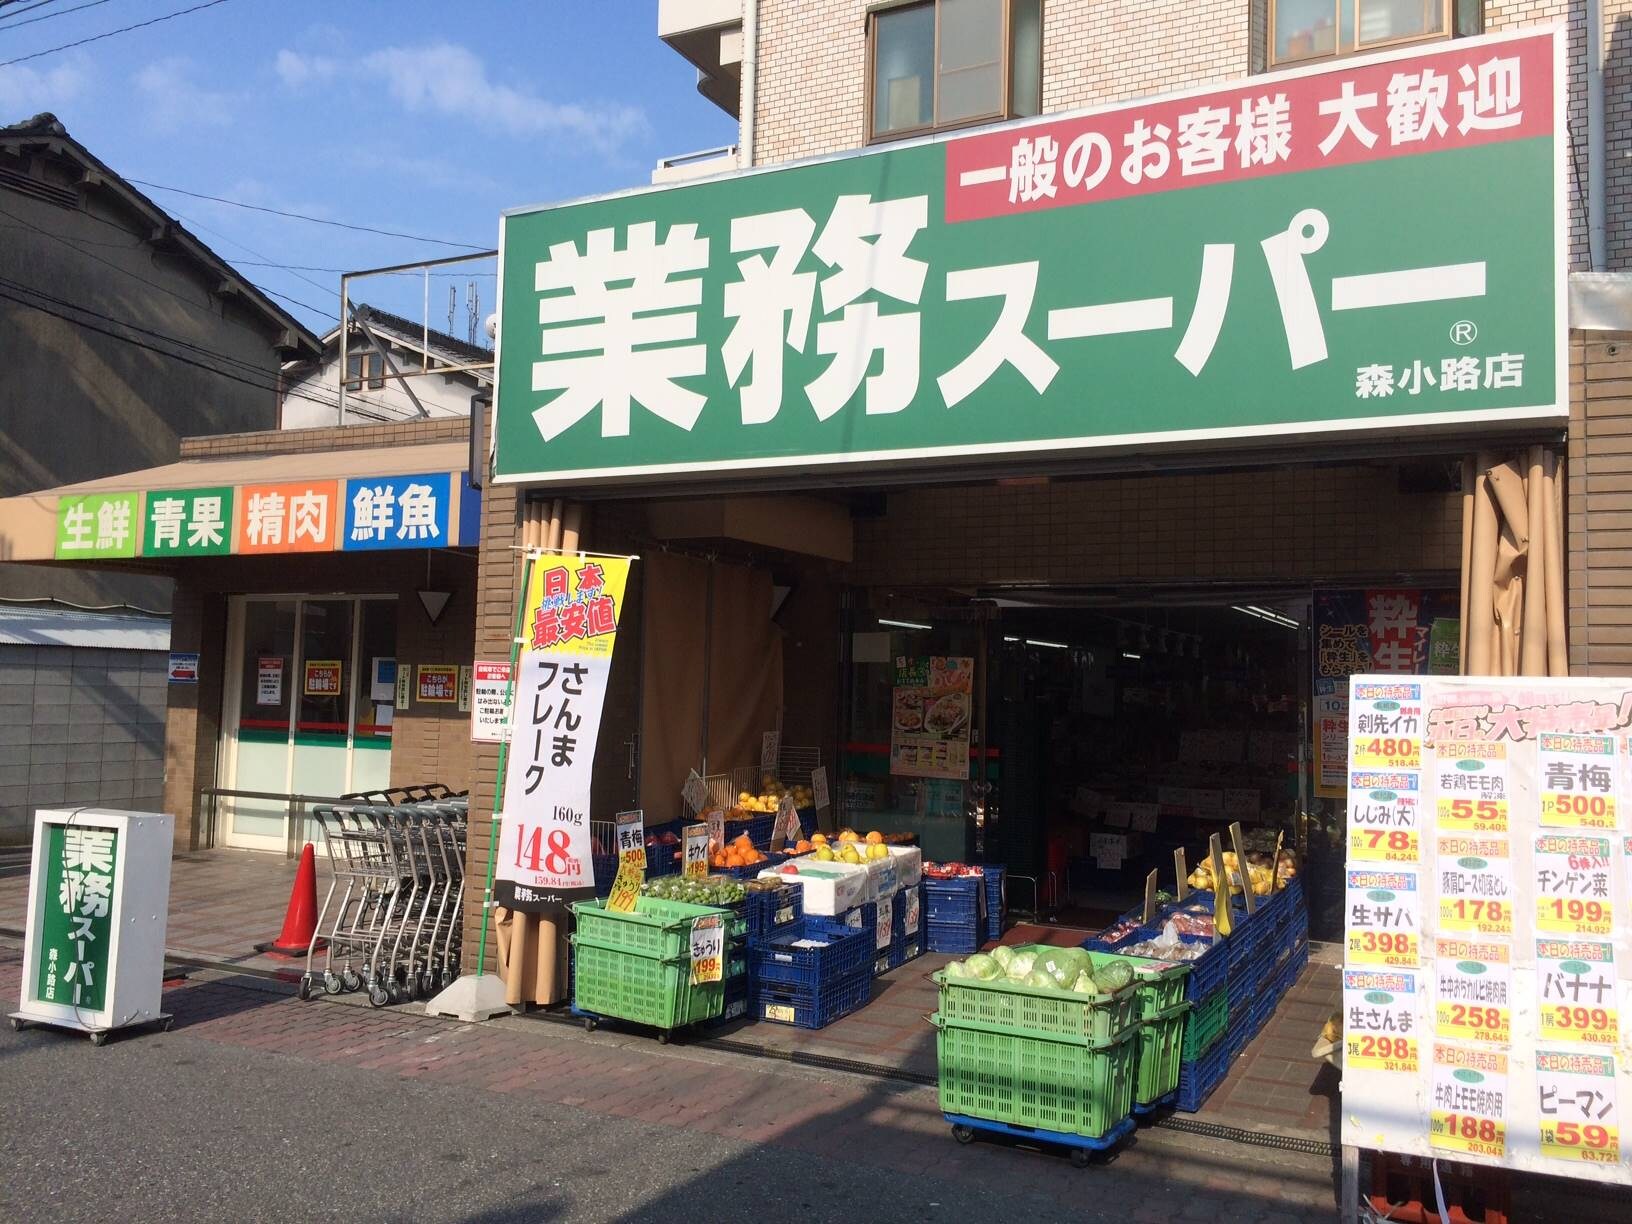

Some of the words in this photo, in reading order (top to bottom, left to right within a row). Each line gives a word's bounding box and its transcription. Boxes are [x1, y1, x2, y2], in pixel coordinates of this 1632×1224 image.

[960, 94, 1292, 204] 一般のお客様
[1319, 56, 1523, 156] 大歓迎
[532, 194, 1486, 442] 業務スーパー
[1356, 352, 1525, 398] 森小路店
[62, 500, 131, 549] 生鮮
[151, 497, 225, 547] 青果
[246, 490, 329, 545] 精肉
[351, 483, 441, 541] 鮮魚
[543, 563, 605, 598] 日本
[531, 595, 617, 650] 最安値
[525, 661, 559, 796] フレーク
[551, 662, 589, 767] さんま
[1358, 714, 1418, 734] 剣先イカ
[1440, 774, 1504, 792] 若鶏モモ肉
[1544, 761, 1612, 792] 青梅
[553, 806, 584, 826] 160g
[1354, 804, 1415, 827] しじみ(大)
[620, 829, 642, 849] 青梅
[513, 886, 563, 902] 業務スーパー
[1537, 870, 1608, 898] チンゲン菜
[59, 828, 115, 1005] 業務スーパー
[692, 938, 721, 957] きゅうり
[45, 948, 59, 1000] 森小路店
[1543, 972, 1612, 1004] バナナ
[1349, 1006, 1413, 1032] 生さんま
[1539, 1084, 1614, 1120] ピーマン
